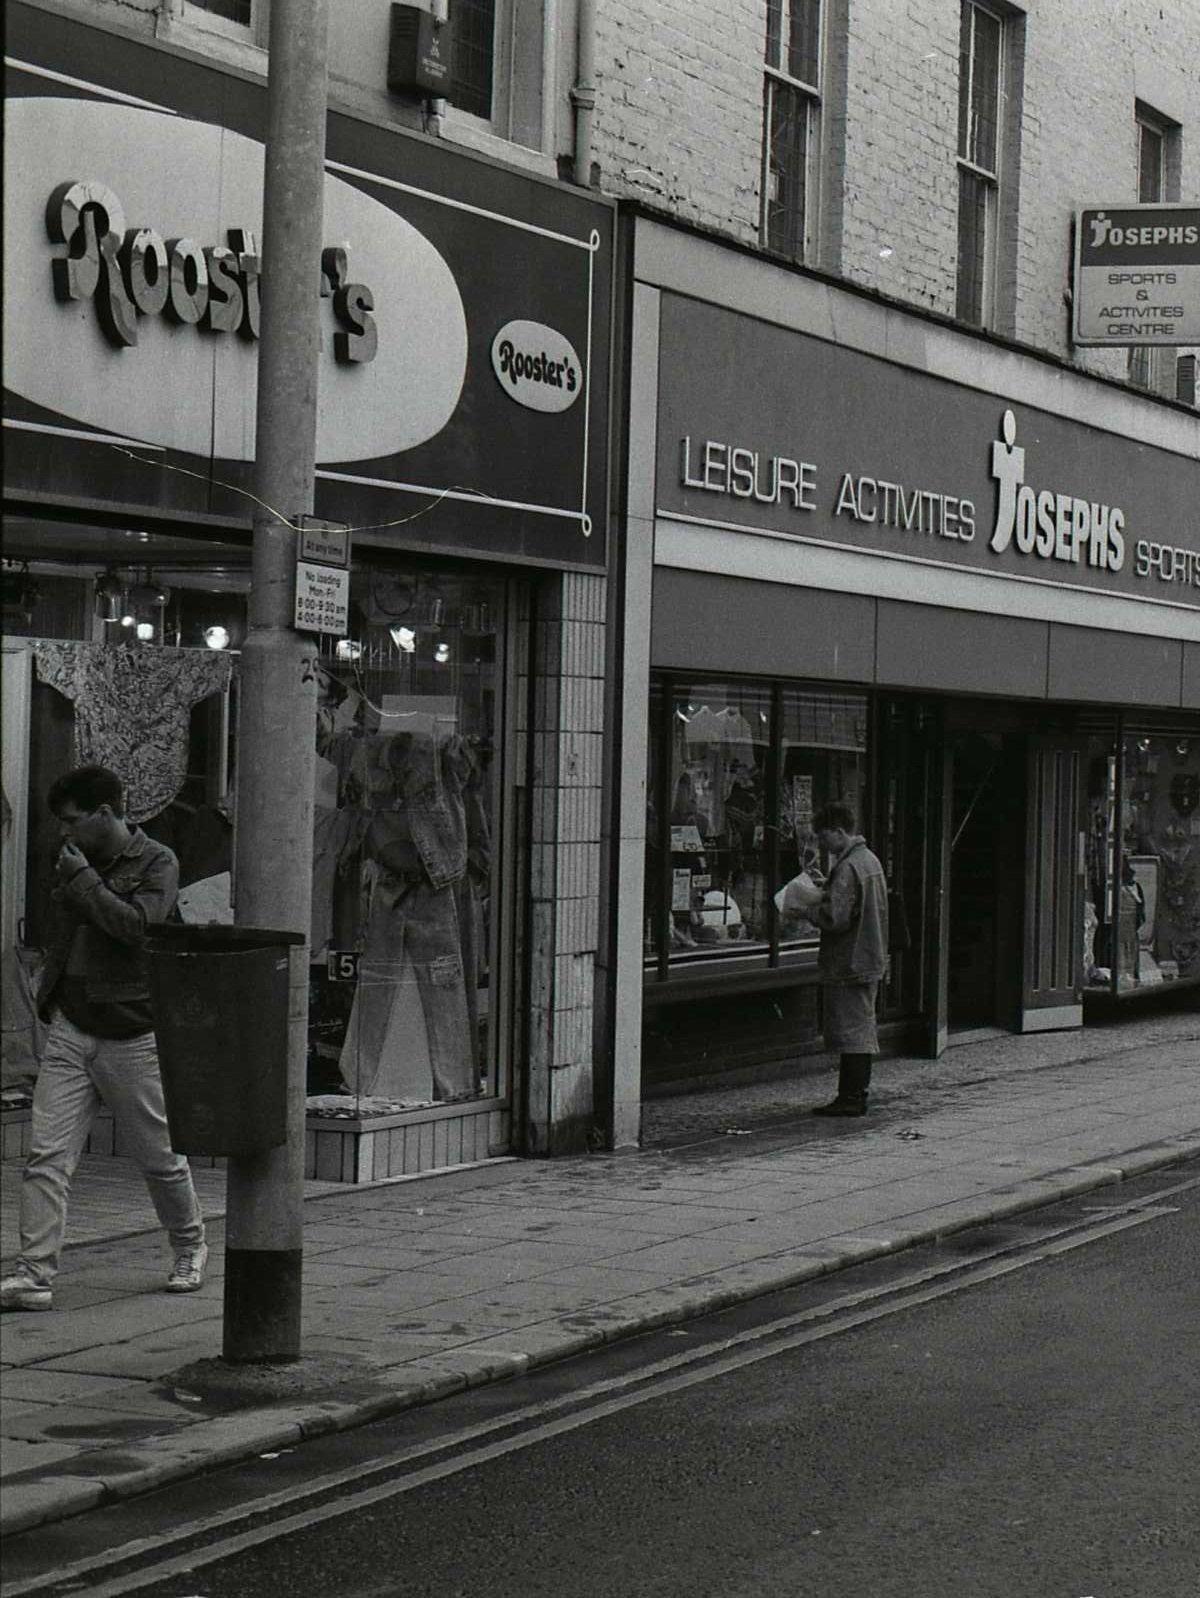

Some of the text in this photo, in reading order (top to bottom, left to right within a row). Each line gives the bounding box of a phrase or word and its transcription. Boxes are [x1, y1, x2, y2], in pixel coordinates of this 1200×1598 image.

[1090, 212, 1199, 248] JOSEPHS
[46, 180, 378, 364] Roost's
[1108, 273, 1177, 285] SPORTS
[1136, 289, 1149, 301] &
[1099, 306, 1184, 318] ACTIVITIES
[1107, 323, 1175, 335] CENTRE
[499, 340, 577, 392] Rooster's
[682, 435, 817, 510] LEISURE
[836, 473, 976, 542] ACTIVITIES
[991, 409, 1125, 572] JOSEPHS
[305, 571, 341, 588] No loading
